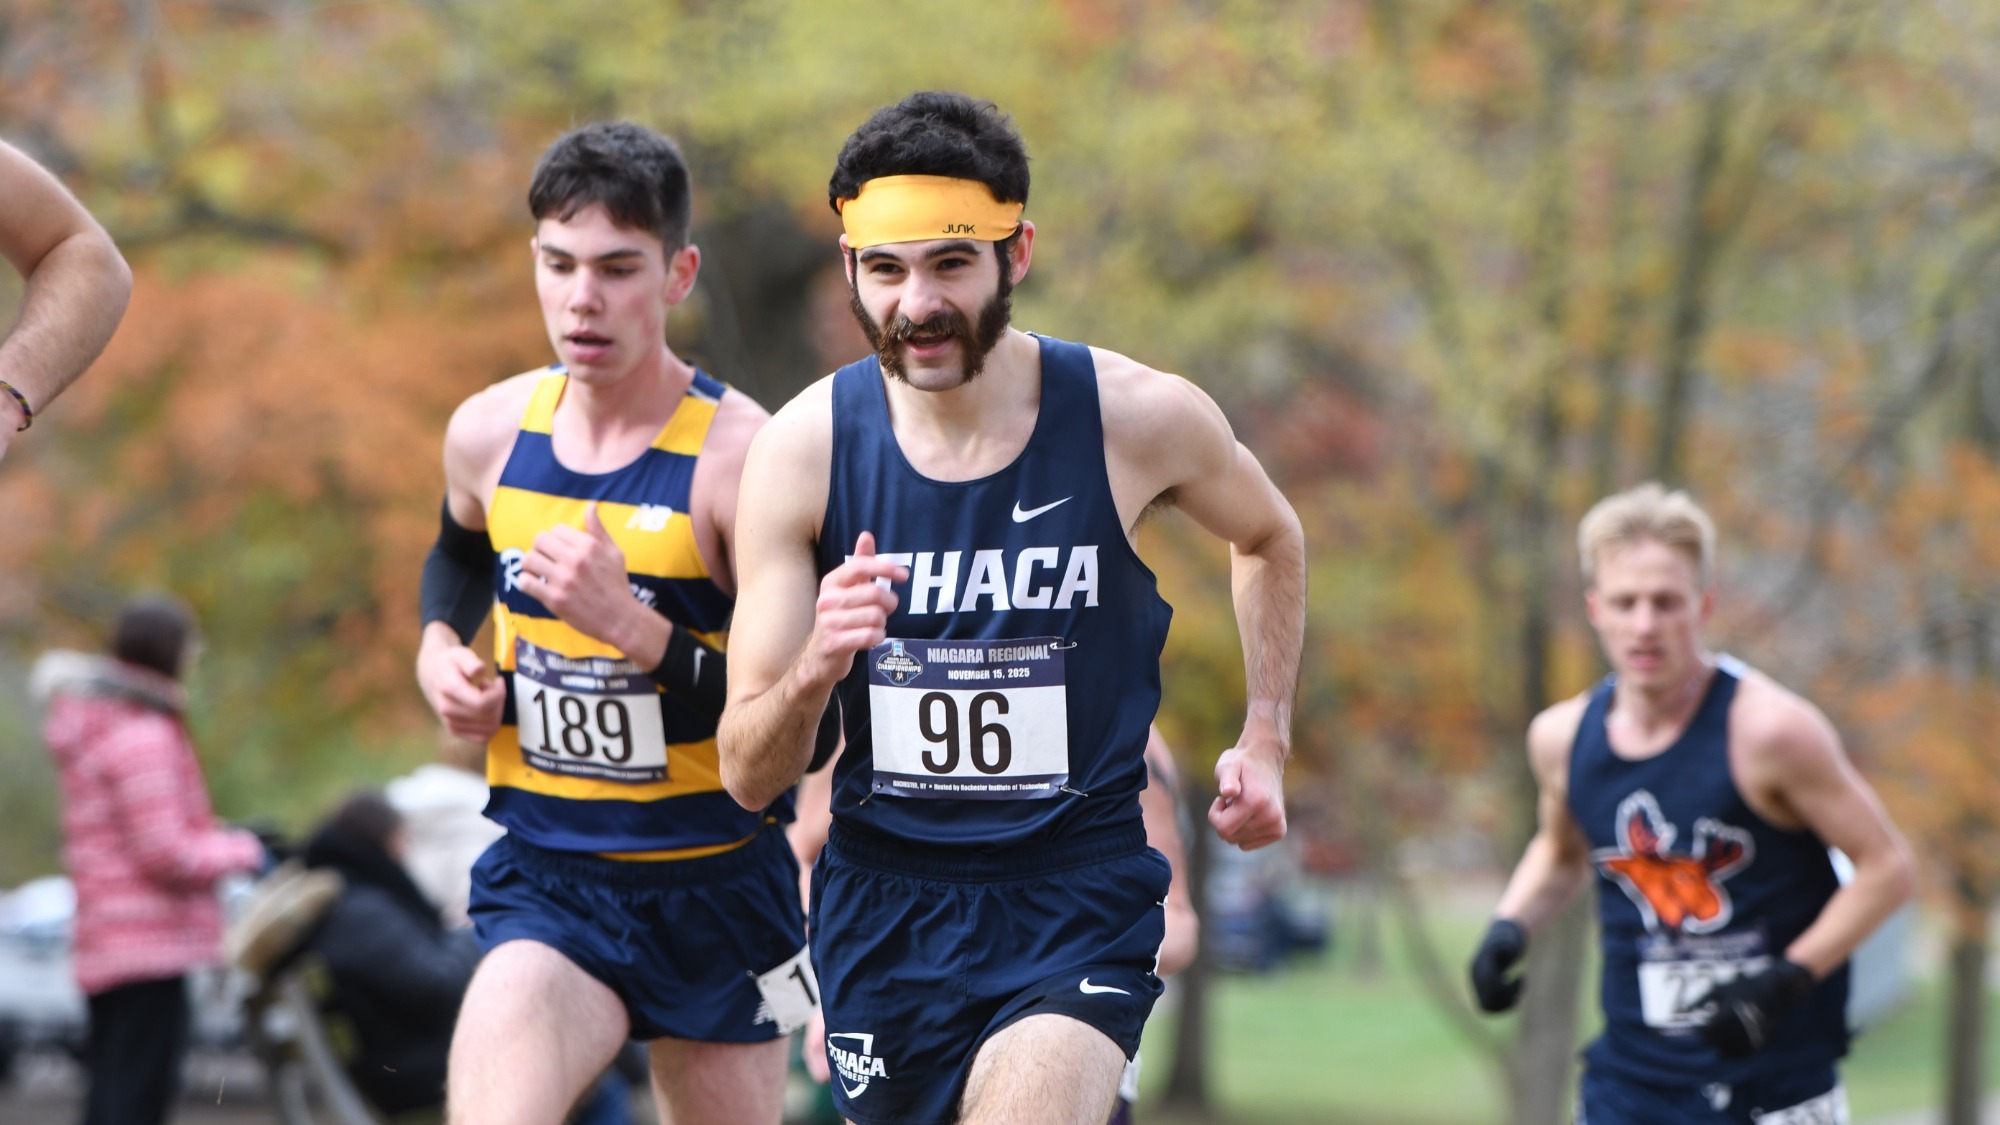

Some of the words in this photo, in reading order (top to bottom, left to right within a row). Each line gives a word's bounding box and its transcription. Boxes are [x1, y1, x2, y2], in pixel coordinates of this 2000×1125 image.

[942, 224, 976, 234] JUNK
[927, 647, 984, 663] NIAGARA
[988, 644, 1050, 663] REGIONAL
[948, 669, 990, 680] NOVEMBER
[992, 669, 1005, 679] 15,
[1007, 667, 1030, 678] 2025
[533, 688, 633, 763] 189
[918, 691, 1012, 775] 96
[1019, 782, 1050, 790] Technology
